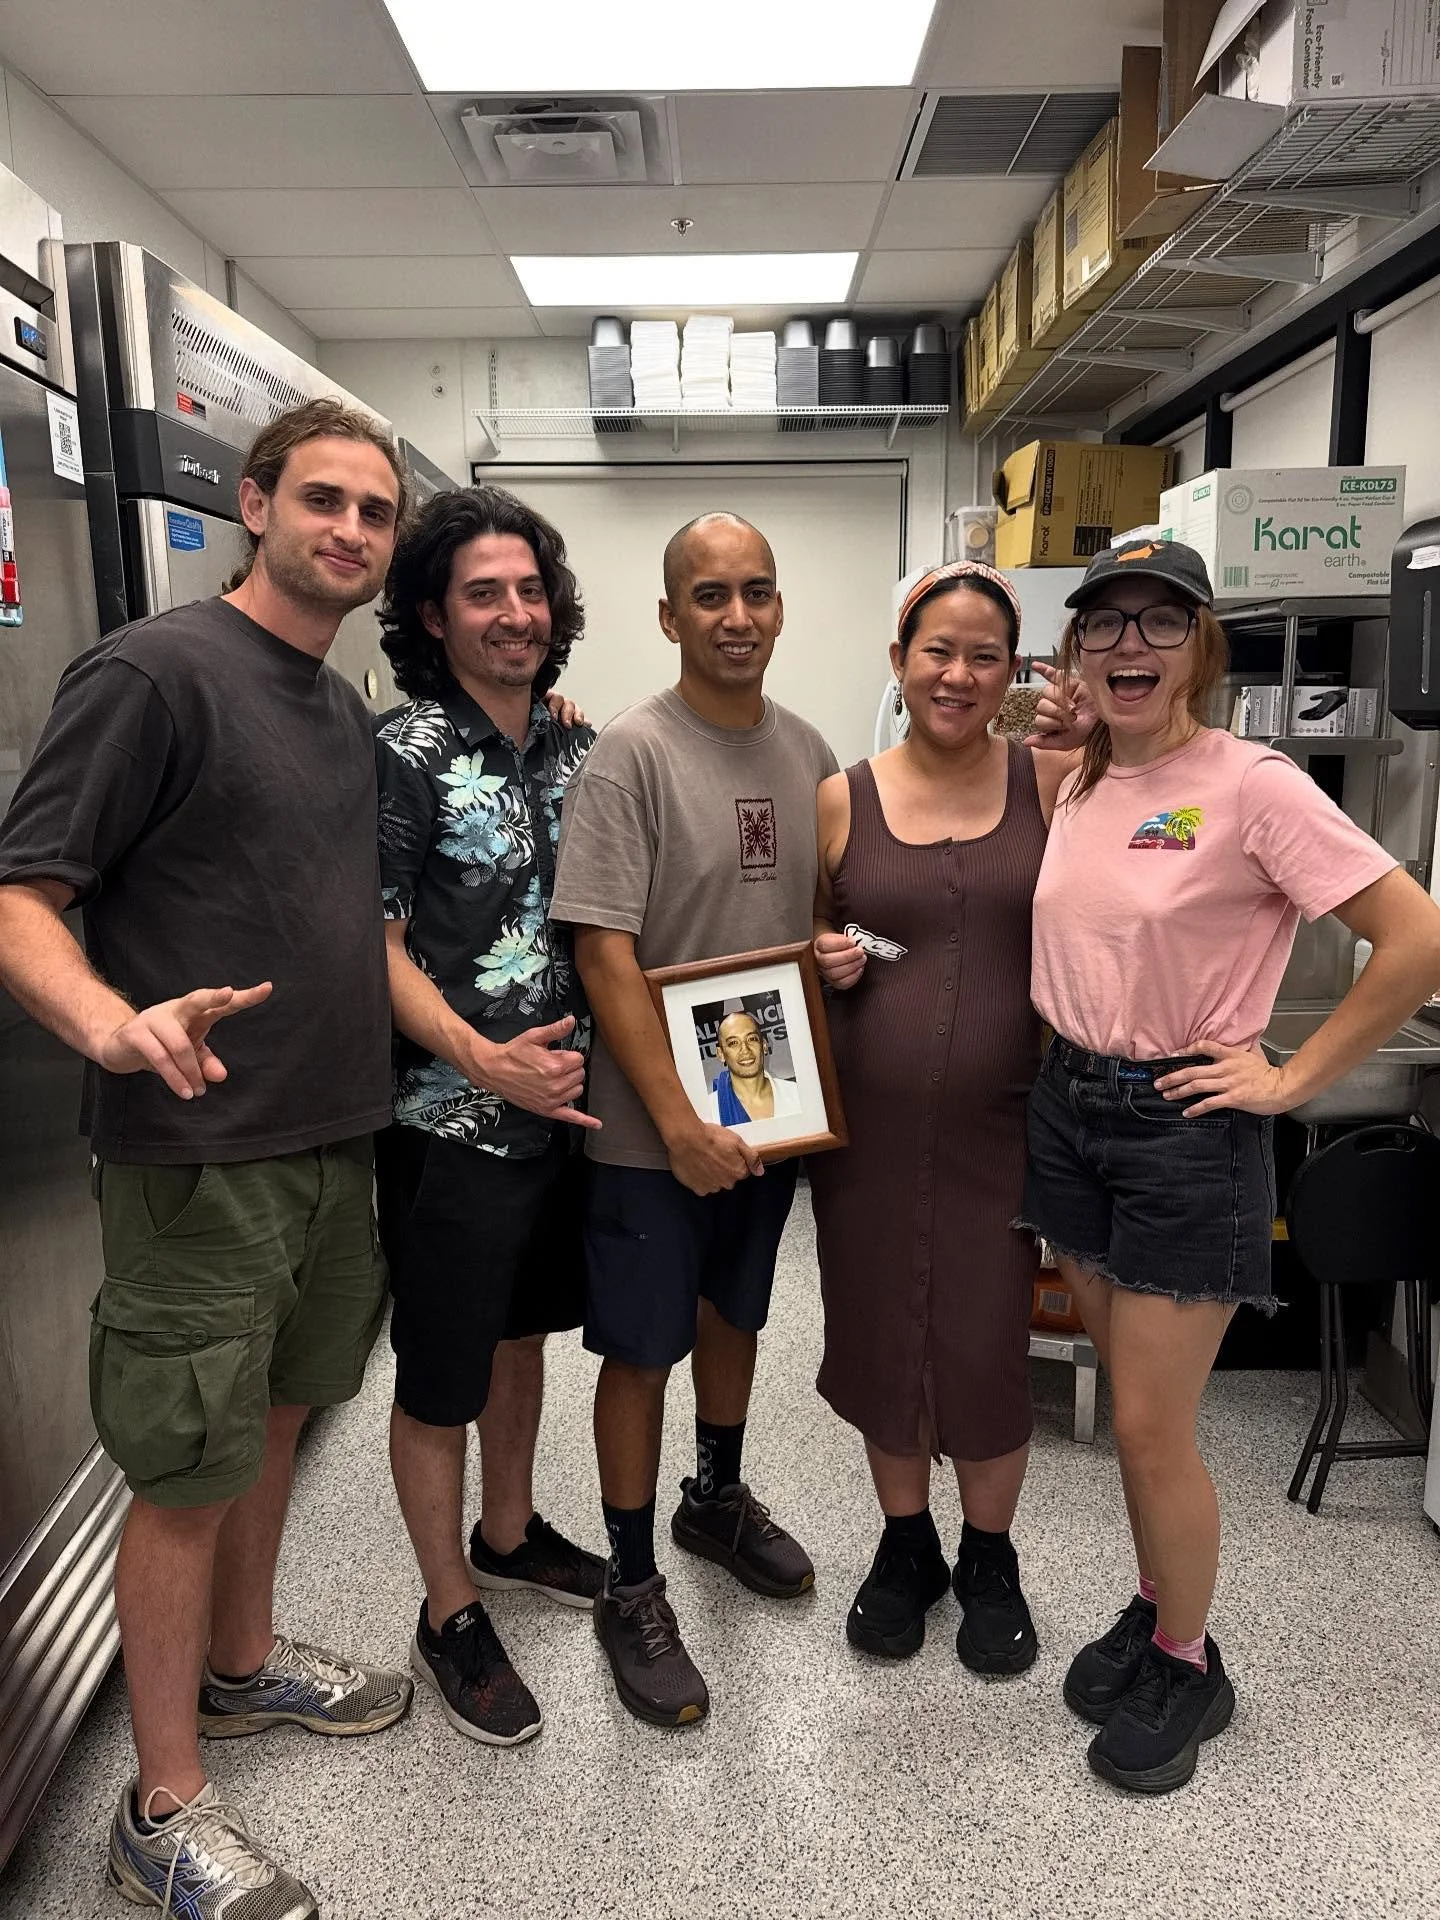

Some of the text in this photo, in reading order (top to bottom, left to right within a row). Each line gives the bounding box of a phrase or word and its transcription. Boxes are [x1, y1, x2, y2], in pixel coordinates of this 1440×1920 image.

[1302, 8, 1314, 90] Food Container
[1311, 24, 1325, 89] Eco-Friendly
[1342, 480, 1394, 491] KE-KDL75
[1324, 553, 1360, 568] earth
[1348, 571, 1390, 579] Compostable
[1366, 578, 1379, 586] Flat
